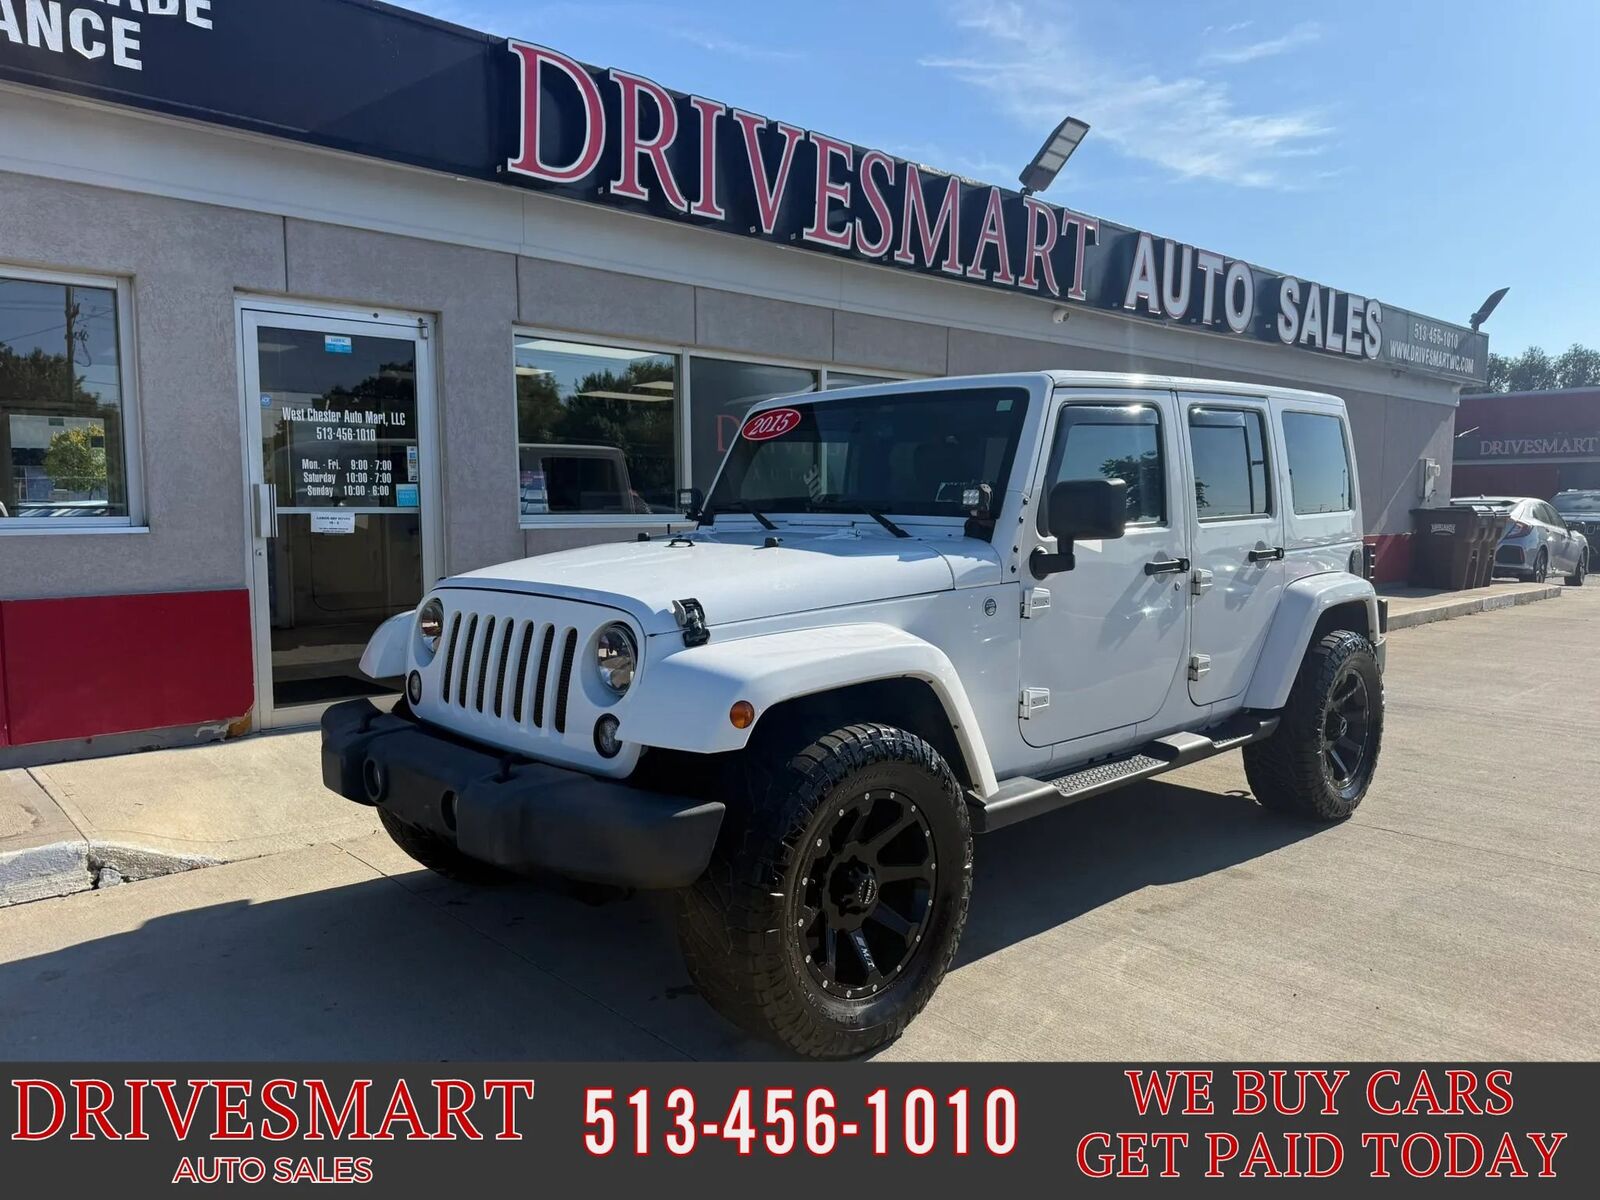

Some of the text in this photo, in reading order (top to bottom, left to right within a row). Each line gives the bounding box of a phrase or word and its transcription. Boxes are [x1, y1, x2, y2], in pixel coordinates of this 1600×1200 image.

[507, 38, 1382, 360] DRIVESMART AUTO SALES
[1413, 323, 1427, 341] 513
[282, 407, 406, 427] West Chester Auto Mart, LLC
[748, 413, 794, 436] 2015
[316, 427, 376, 441] 513-456-1010
[1480, 437, 1599, 455] DRIVESMART
[302, 459, 320, 470] Mon.
[328, 459, 341, 470] Fri.
[350, 460, 368, 471] 9:00
[375, 460, 392, 471] 7:00
[303, 472, 336, 485] Saturday
[346, 472, 368, 483] 10:00
[375, 473, 392, 484] 7:00
[307, 485, 334, 497] Sunday
[344, 486, 365, 496] 10:00
[372, 486, 389, 496] 6:00
